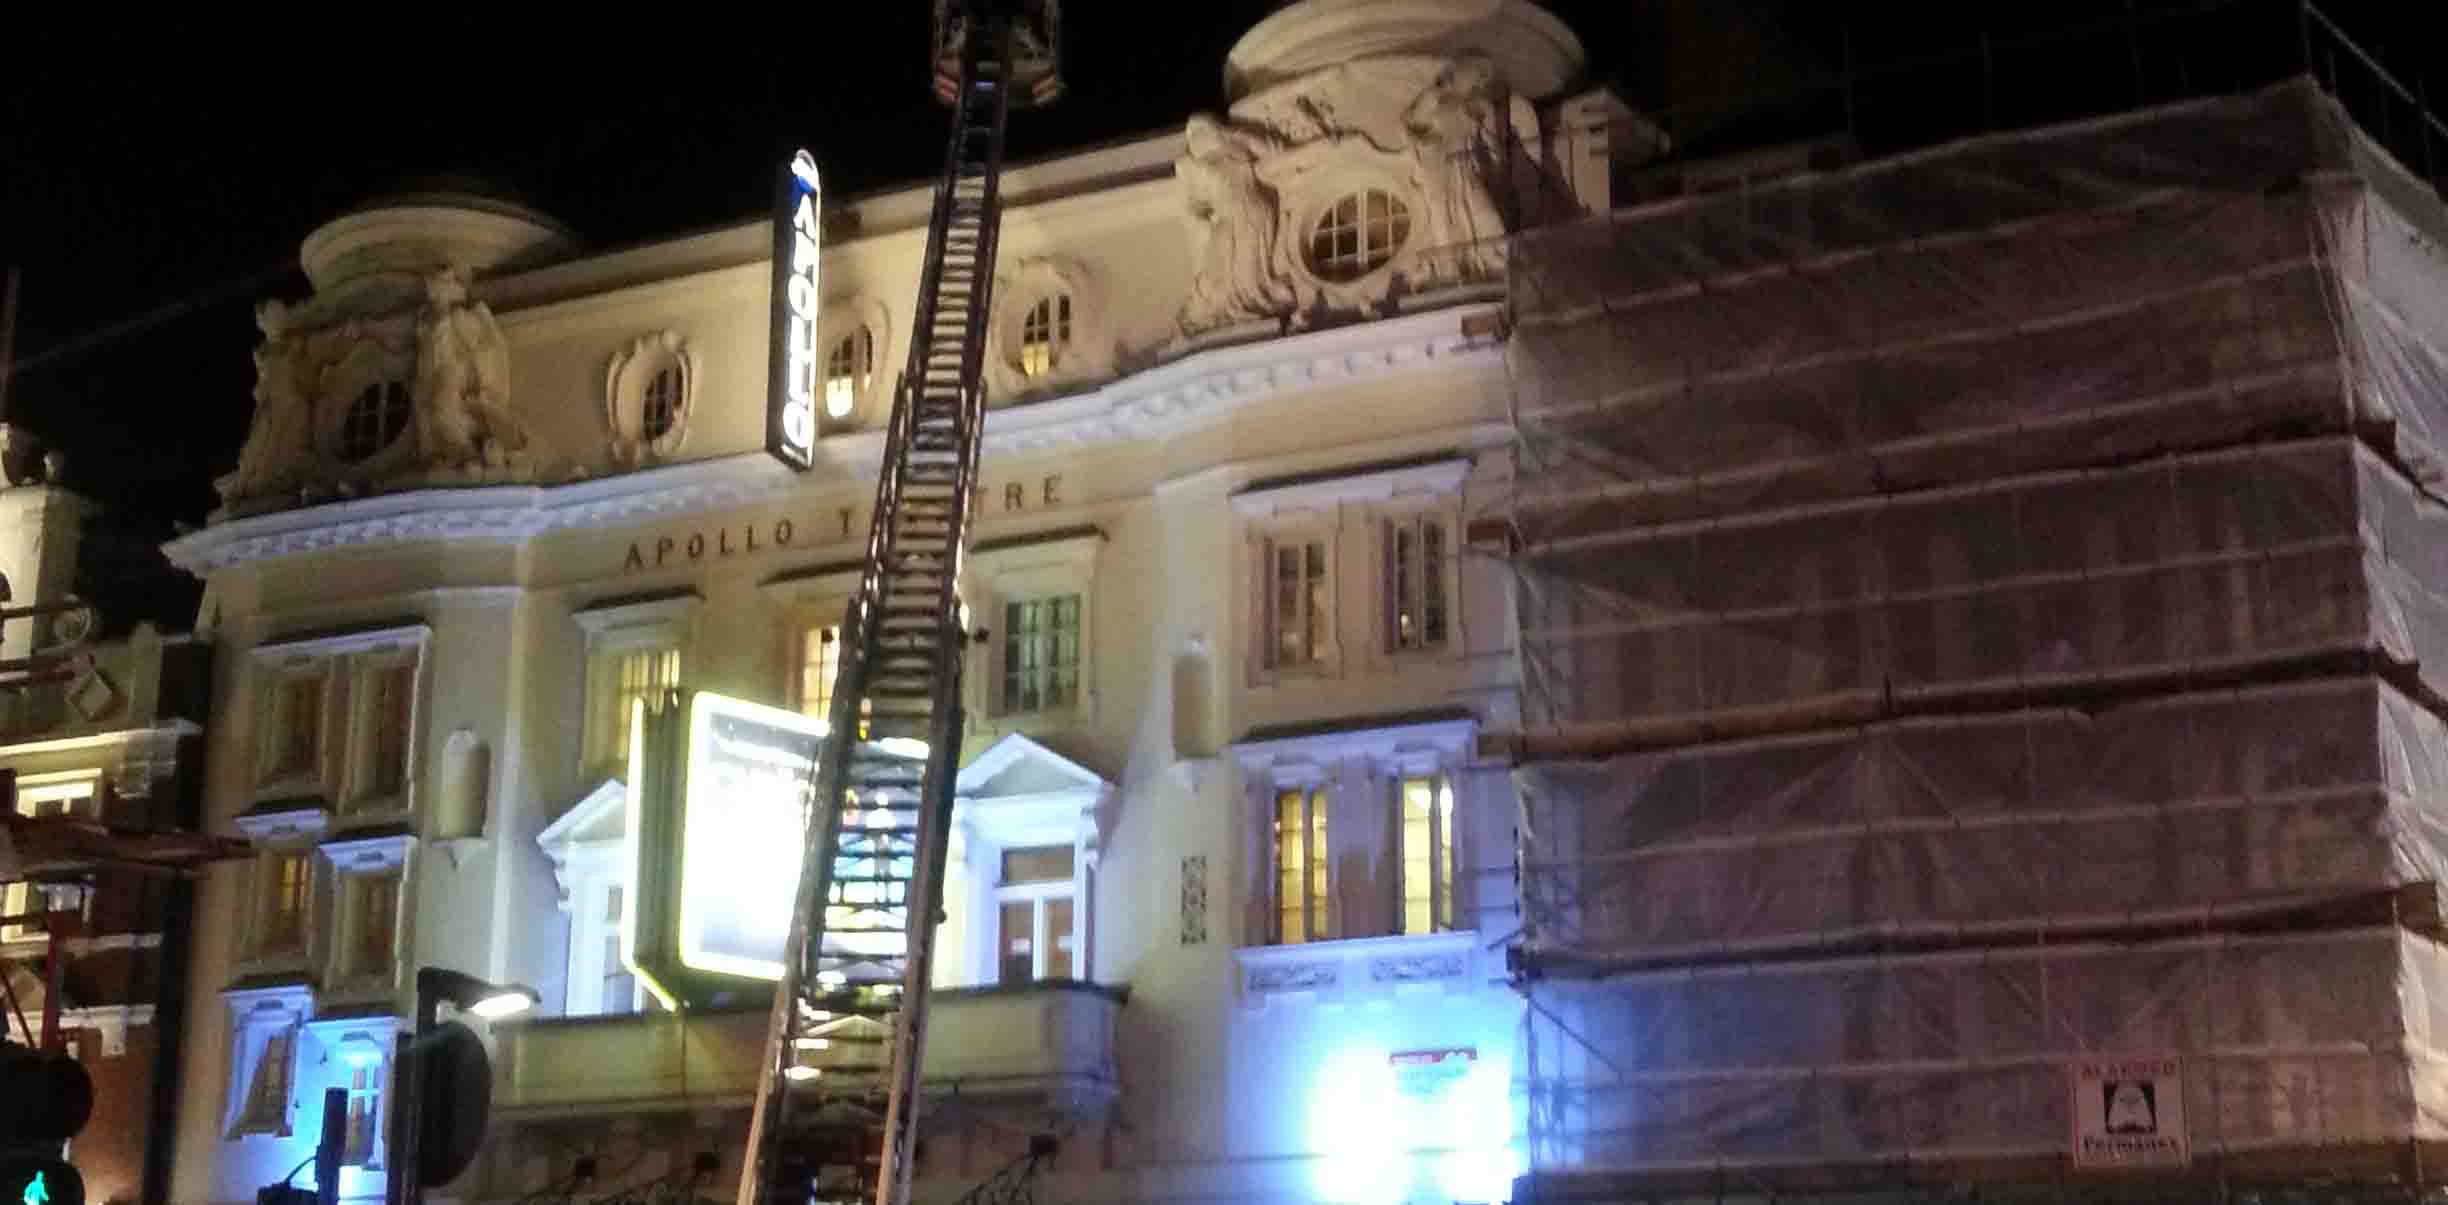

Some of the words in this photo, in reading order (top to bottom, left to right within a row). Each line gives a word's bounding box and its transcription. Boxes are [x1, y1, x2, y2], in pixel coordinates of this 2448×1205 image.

[782, 193, 817, 449] APOLLO
[624, 517, 793, 569] APOLLO
[839, 473, 1062, 536] TTRE
